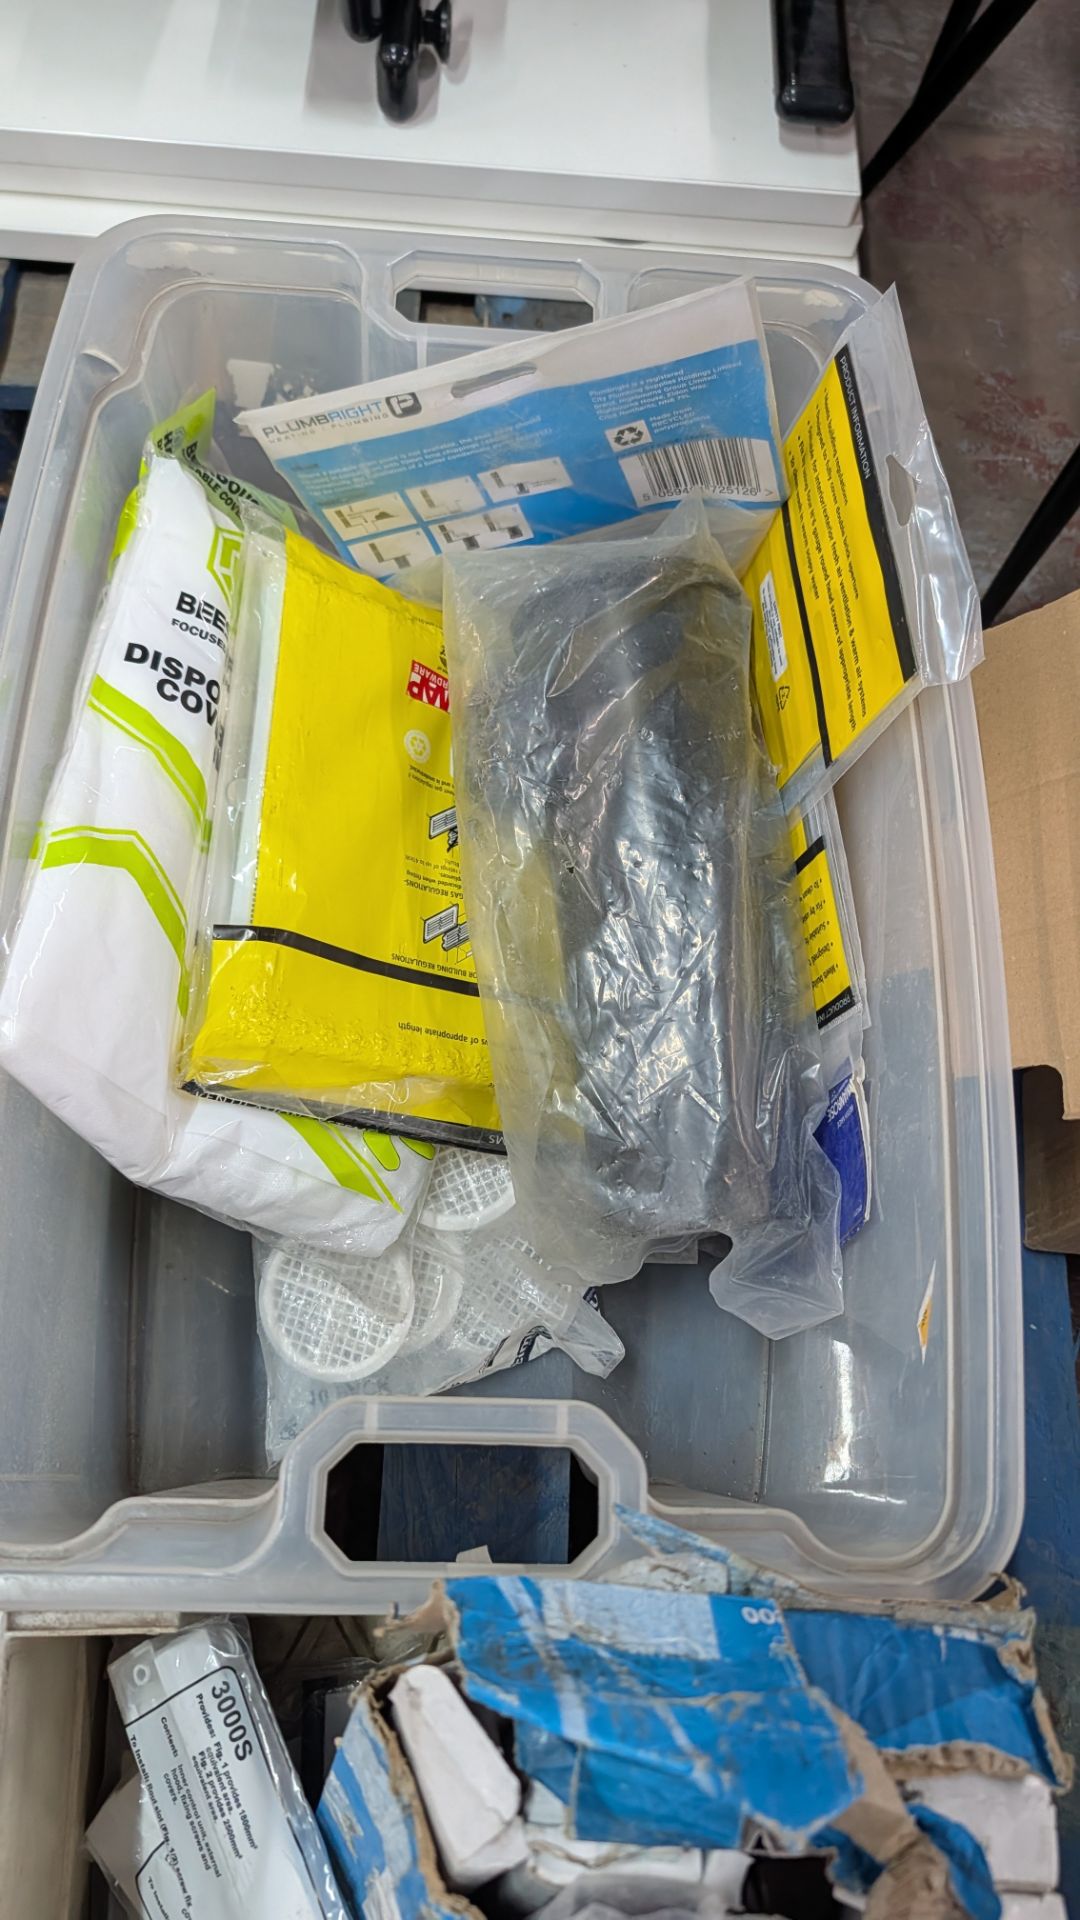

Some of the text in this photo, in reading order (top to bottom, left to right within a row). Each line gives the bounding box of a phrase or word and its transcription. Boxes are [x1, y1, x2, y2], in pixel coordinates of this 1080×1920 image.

[261, 400, 382, 439] PLUMBRIGHT
[331, 412, 389, 430] PLUMBING
[838, 355, 872, 479] PRODUCT INFORMATION
[642, 493, 650, 501] 5
[812, 524, 822, 557] gauge
[818, 550, 829, 584] round
[176, 591, 231, 640] BEE
[814, 470, 833, 546] interior/exterior
[830, 539, 839, 568] fresh
[838, 577, 853, 629] ventilation
[850, 633, 859, 669] warm
[857, 676, 867, 722] systems
[171, 618, 227, 654] FOCUSE
[124, 642, 221, 705] DISPO
[156, 678, 219, 727] COV
[390, 952, 435, 969] REGULATIONS
[436, 963, 466, 976] BUILDING
[397, 1020, 479, 1045] of appropriate length
[211, 1680, 253, 1761] 3000S
[189, 1754, 211, 1801] equivalent
[194, 1692, 218, 1739] Provides:
[211, 1740, 226, 1762] Fig.
[222, 1768, 244, 1810] provides
[203, 1744, 235, 1815] equivalent area.
[196, 1749, 209, 1771] Fig.
[205, 1778, 227, 1819] provides
[153, 1804, 164, 1822] slot
[173, 1866, 188, 1894] screw
[169, 1767, 212, 1871] hood, fixing screws and
[176, 1762, 222, 1878] Inner control unit, external
